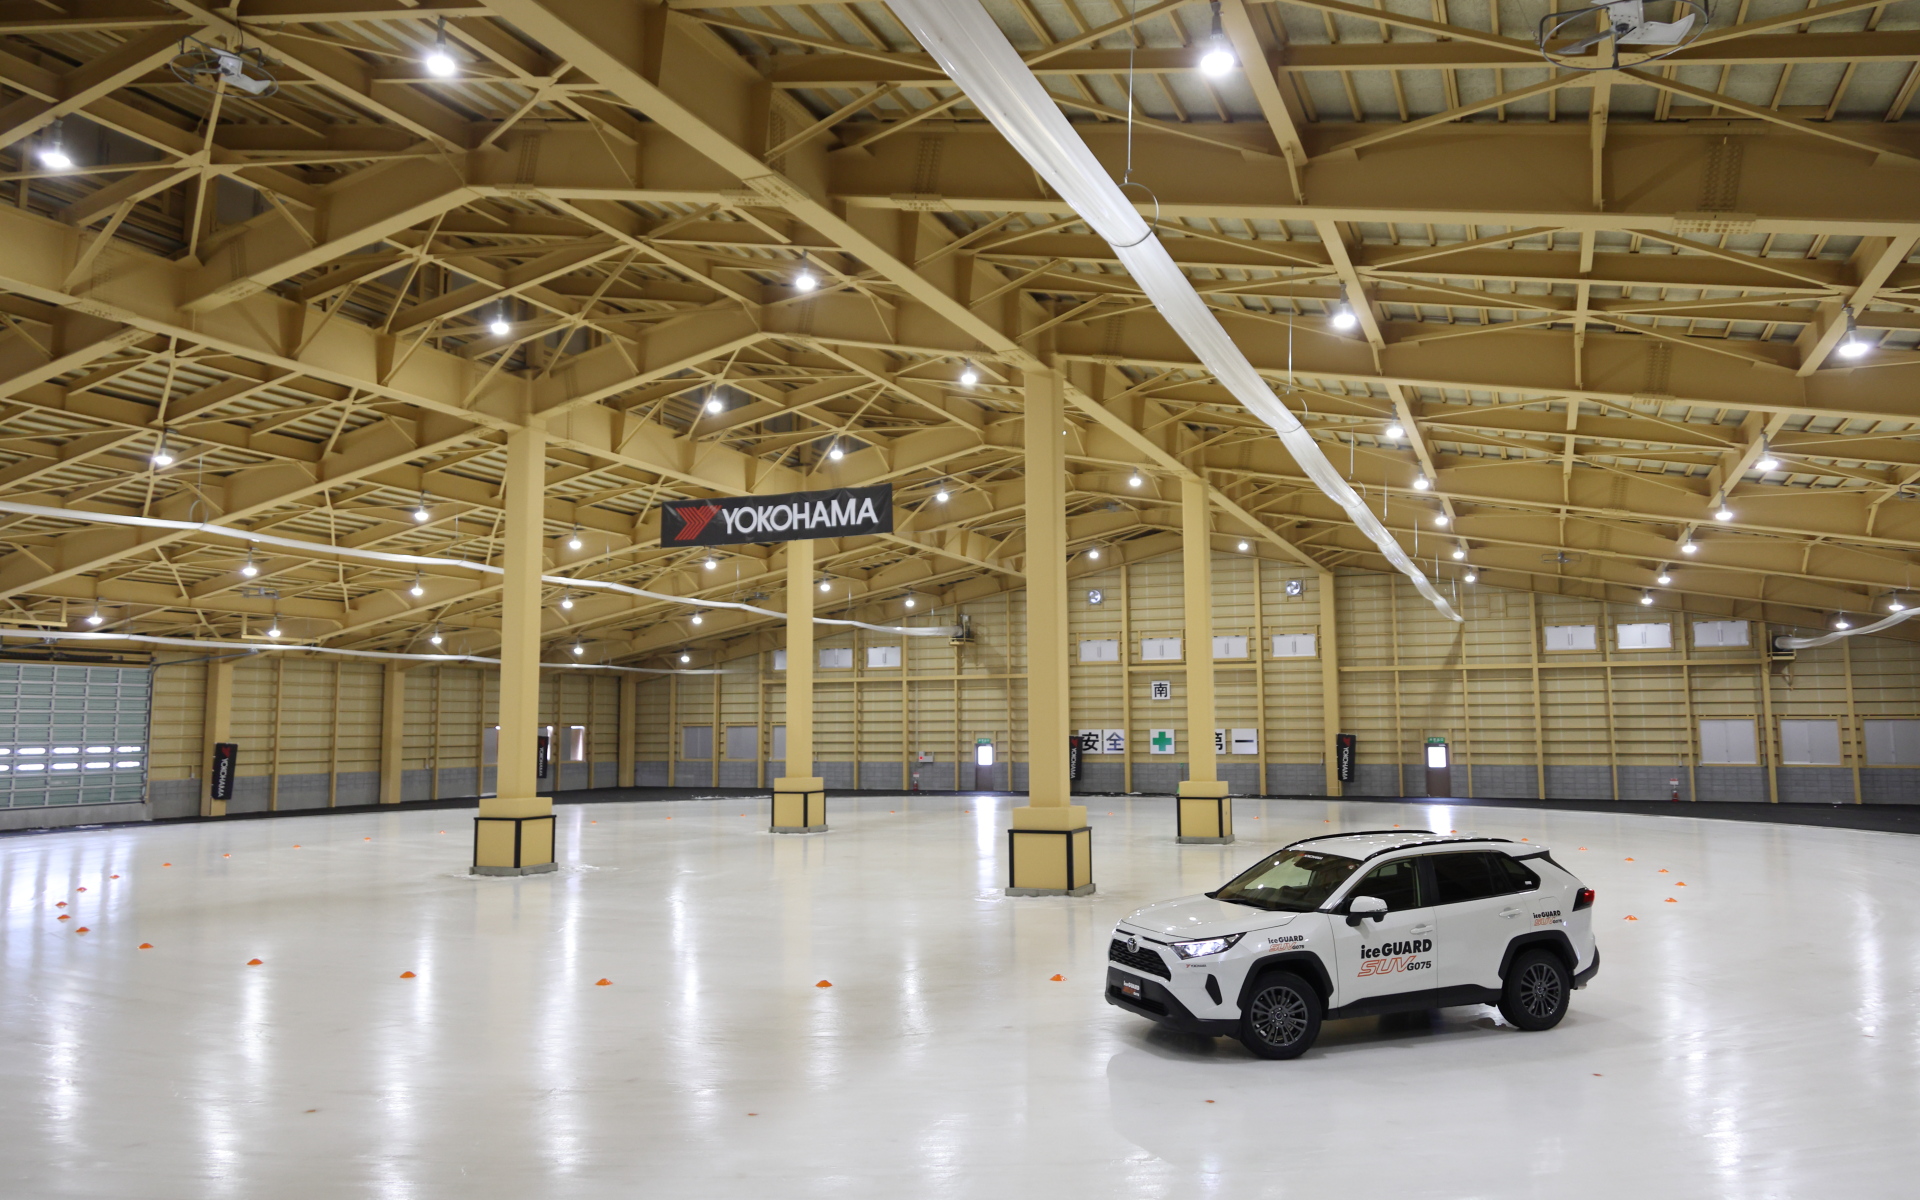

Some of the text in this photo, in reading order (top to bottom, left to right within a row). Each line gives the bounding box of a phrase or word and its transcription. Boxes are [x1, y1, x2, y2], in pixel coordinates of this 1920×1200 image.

[722, 498, 878, 534] YOKOHAMA
[1153, 682, 1168, 698] 南
[1082, 731, 1124, 751] 安全
[217, 757, 228, 797] YOKOHAMA
[1267, 935, 1304, 944] iceGUARD
[1361, 939, 1432, 959] iceGUARD
[1357, 955, 1432, 977] SUV G075
